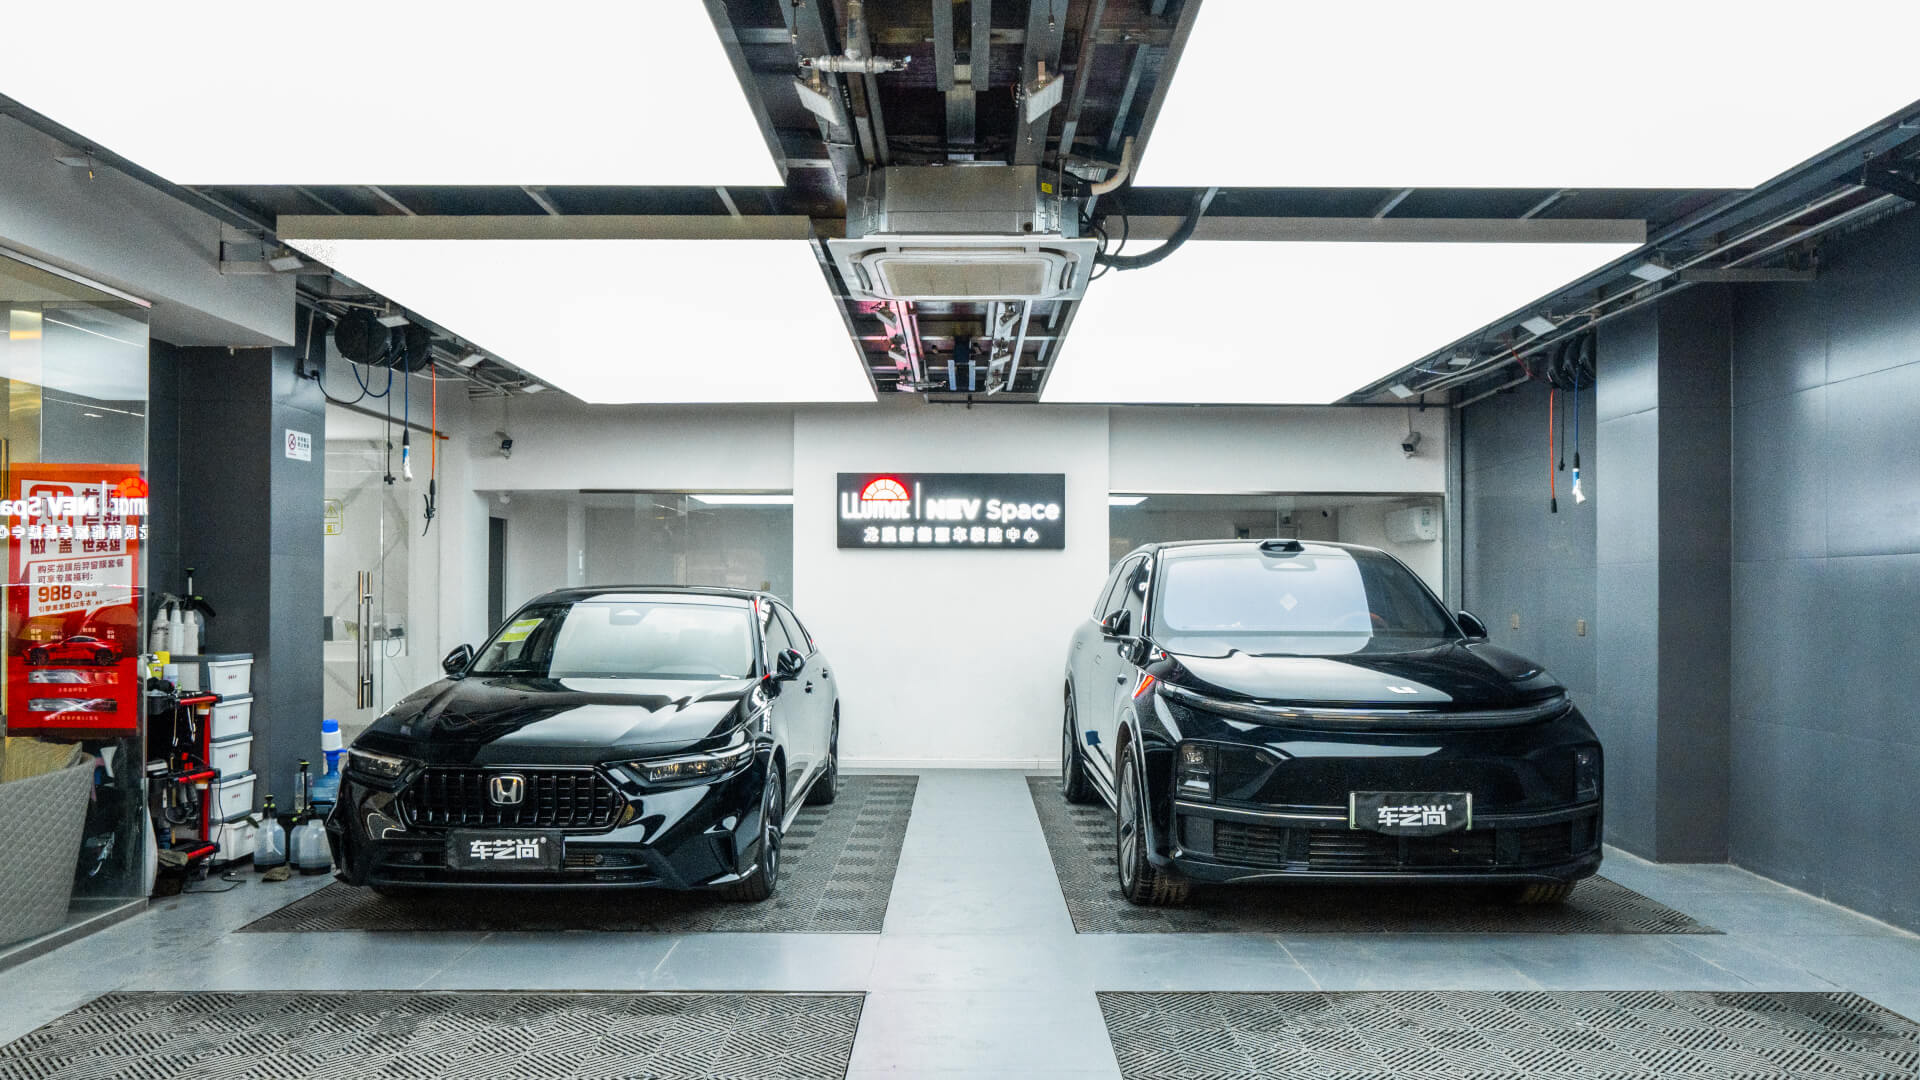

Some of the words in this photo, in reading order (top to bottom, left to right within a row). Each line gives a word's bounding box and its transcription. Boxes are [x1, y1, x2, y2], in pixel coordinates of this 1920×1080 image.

[926, 498, 982, 520] NEV
[986, 498, 1061, 523] Space
[38, 585, 71, 602] 988
[1378, 804, 1447, 827] 车艺尚
[470, 838, 540, 860] 车艺尚
